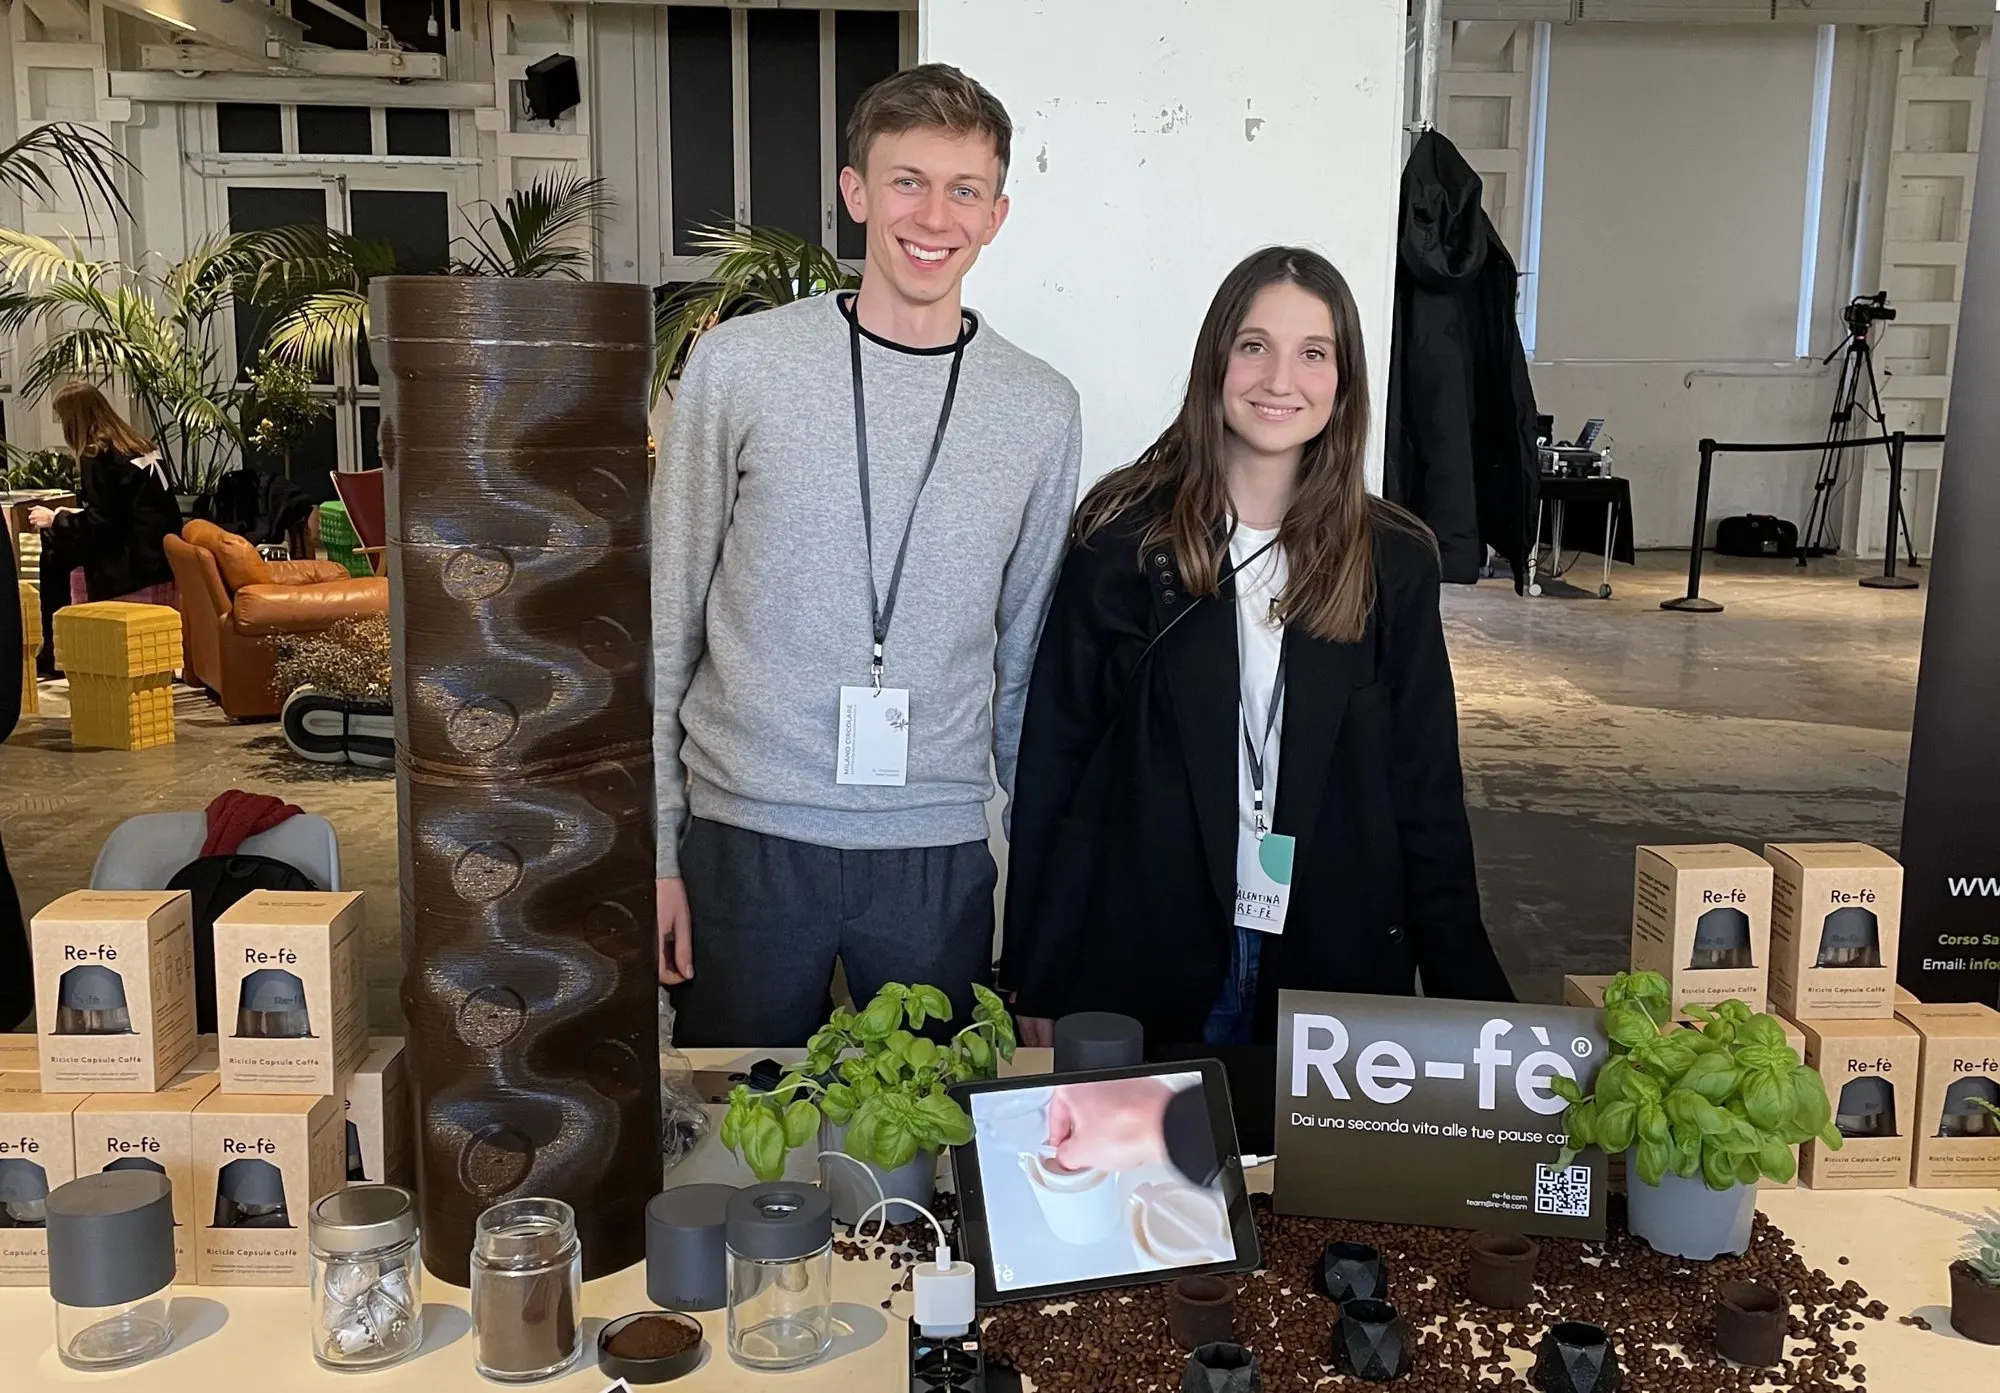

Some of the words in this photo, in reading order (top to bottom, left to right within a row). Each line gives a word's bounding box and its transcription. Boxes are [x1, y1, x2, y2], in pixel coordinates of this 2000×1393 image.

[1236, 889, 1280, 904] ALENTINA
[1703, 888, 1747, 903] Re-fè
[1830, 888, 1876, 903] Re-fè
[1237, 903, 1272, 918] RE-FÈ
[1938, 934, 1979, 945] Corso
[64, 944, 118, 961] Re-fè
[245, 948, 298, 964] Re-fè
[1922, 958, 1966, 970] Email:
[1969, 957, 2000, 970] info
[1707, 987, 1736, 995] Capsule
[81, 1056, 116, 1064] Capsule
[117, 1055, 142, 1063] Caffè
[259, 1058, 293, 1067] Capsule
[295, 1058, 319, 1066] Caffè
[1847, 1058, 1892, 1072] Re-fè
[1953, 1058, 2000, 1072] Re-fè
[1291, 1112, 1315, 1127] Dai
[1318, 1117, 1345, 1129] una
[1348, 1117, 1410, 1134] seconda
[1412, 1121, 1439, 1136] vita
[1442, 1123, 1468, 1138] alle
[1471, 1126, 1495, 1140] tue
[1498, 1129, 1543, 1144] pause
[0, 1137, 40, 1153] e-fè
[107, 1136, 161, 1153] Re-fè
[223, 1138, 276, 1154] Re-fè
[3, 1249, 38, 1257] Capsule
[237, 1248, 271, 1258] Capsule
[273, 1248, 297, 1256] Caffè
